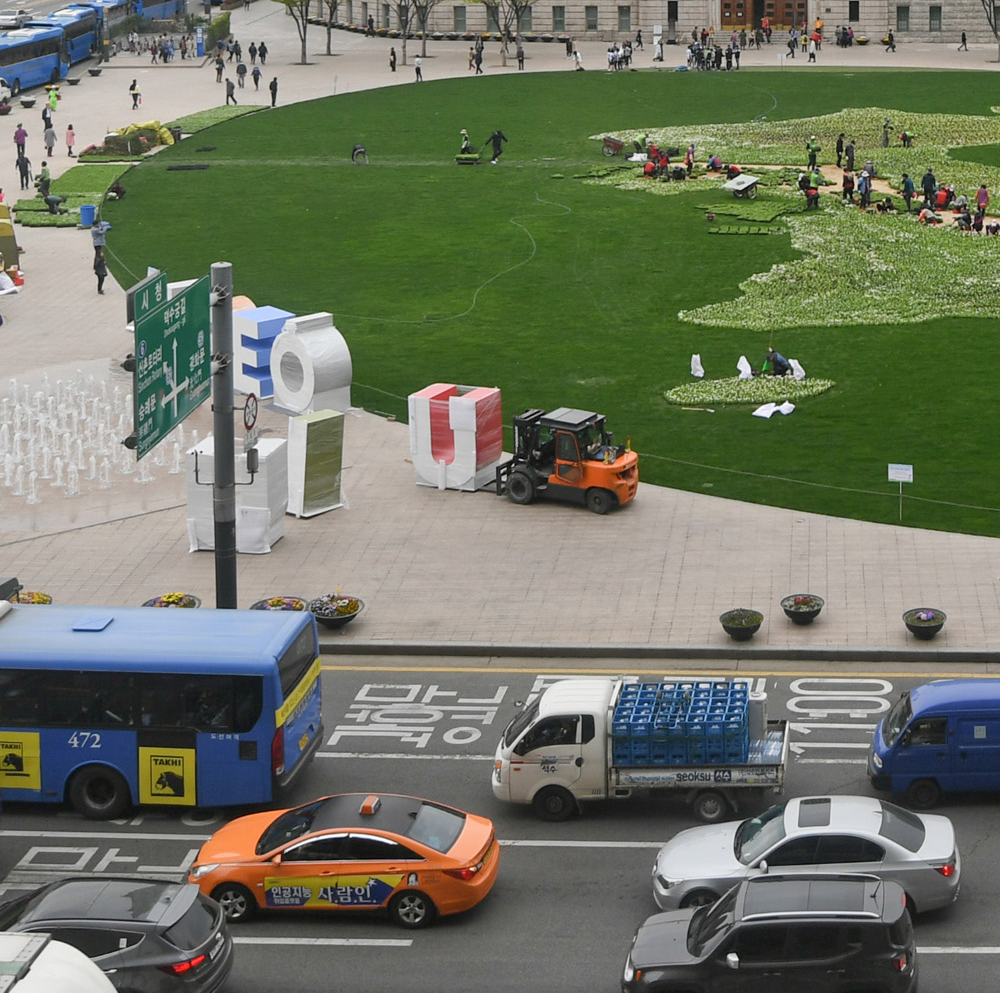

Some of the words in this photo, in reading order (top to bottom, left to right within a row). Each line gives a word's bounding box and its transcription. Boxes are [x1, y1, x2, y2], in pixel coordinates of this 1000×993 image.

[326, 683, 508, 748] 광화문
[67, 731, 102, 749] 472
[153, 758, 181, 766] TAKHI
[676, 771, 711, 782] seoksu
[271, 886, 312, 898] 인공지능
